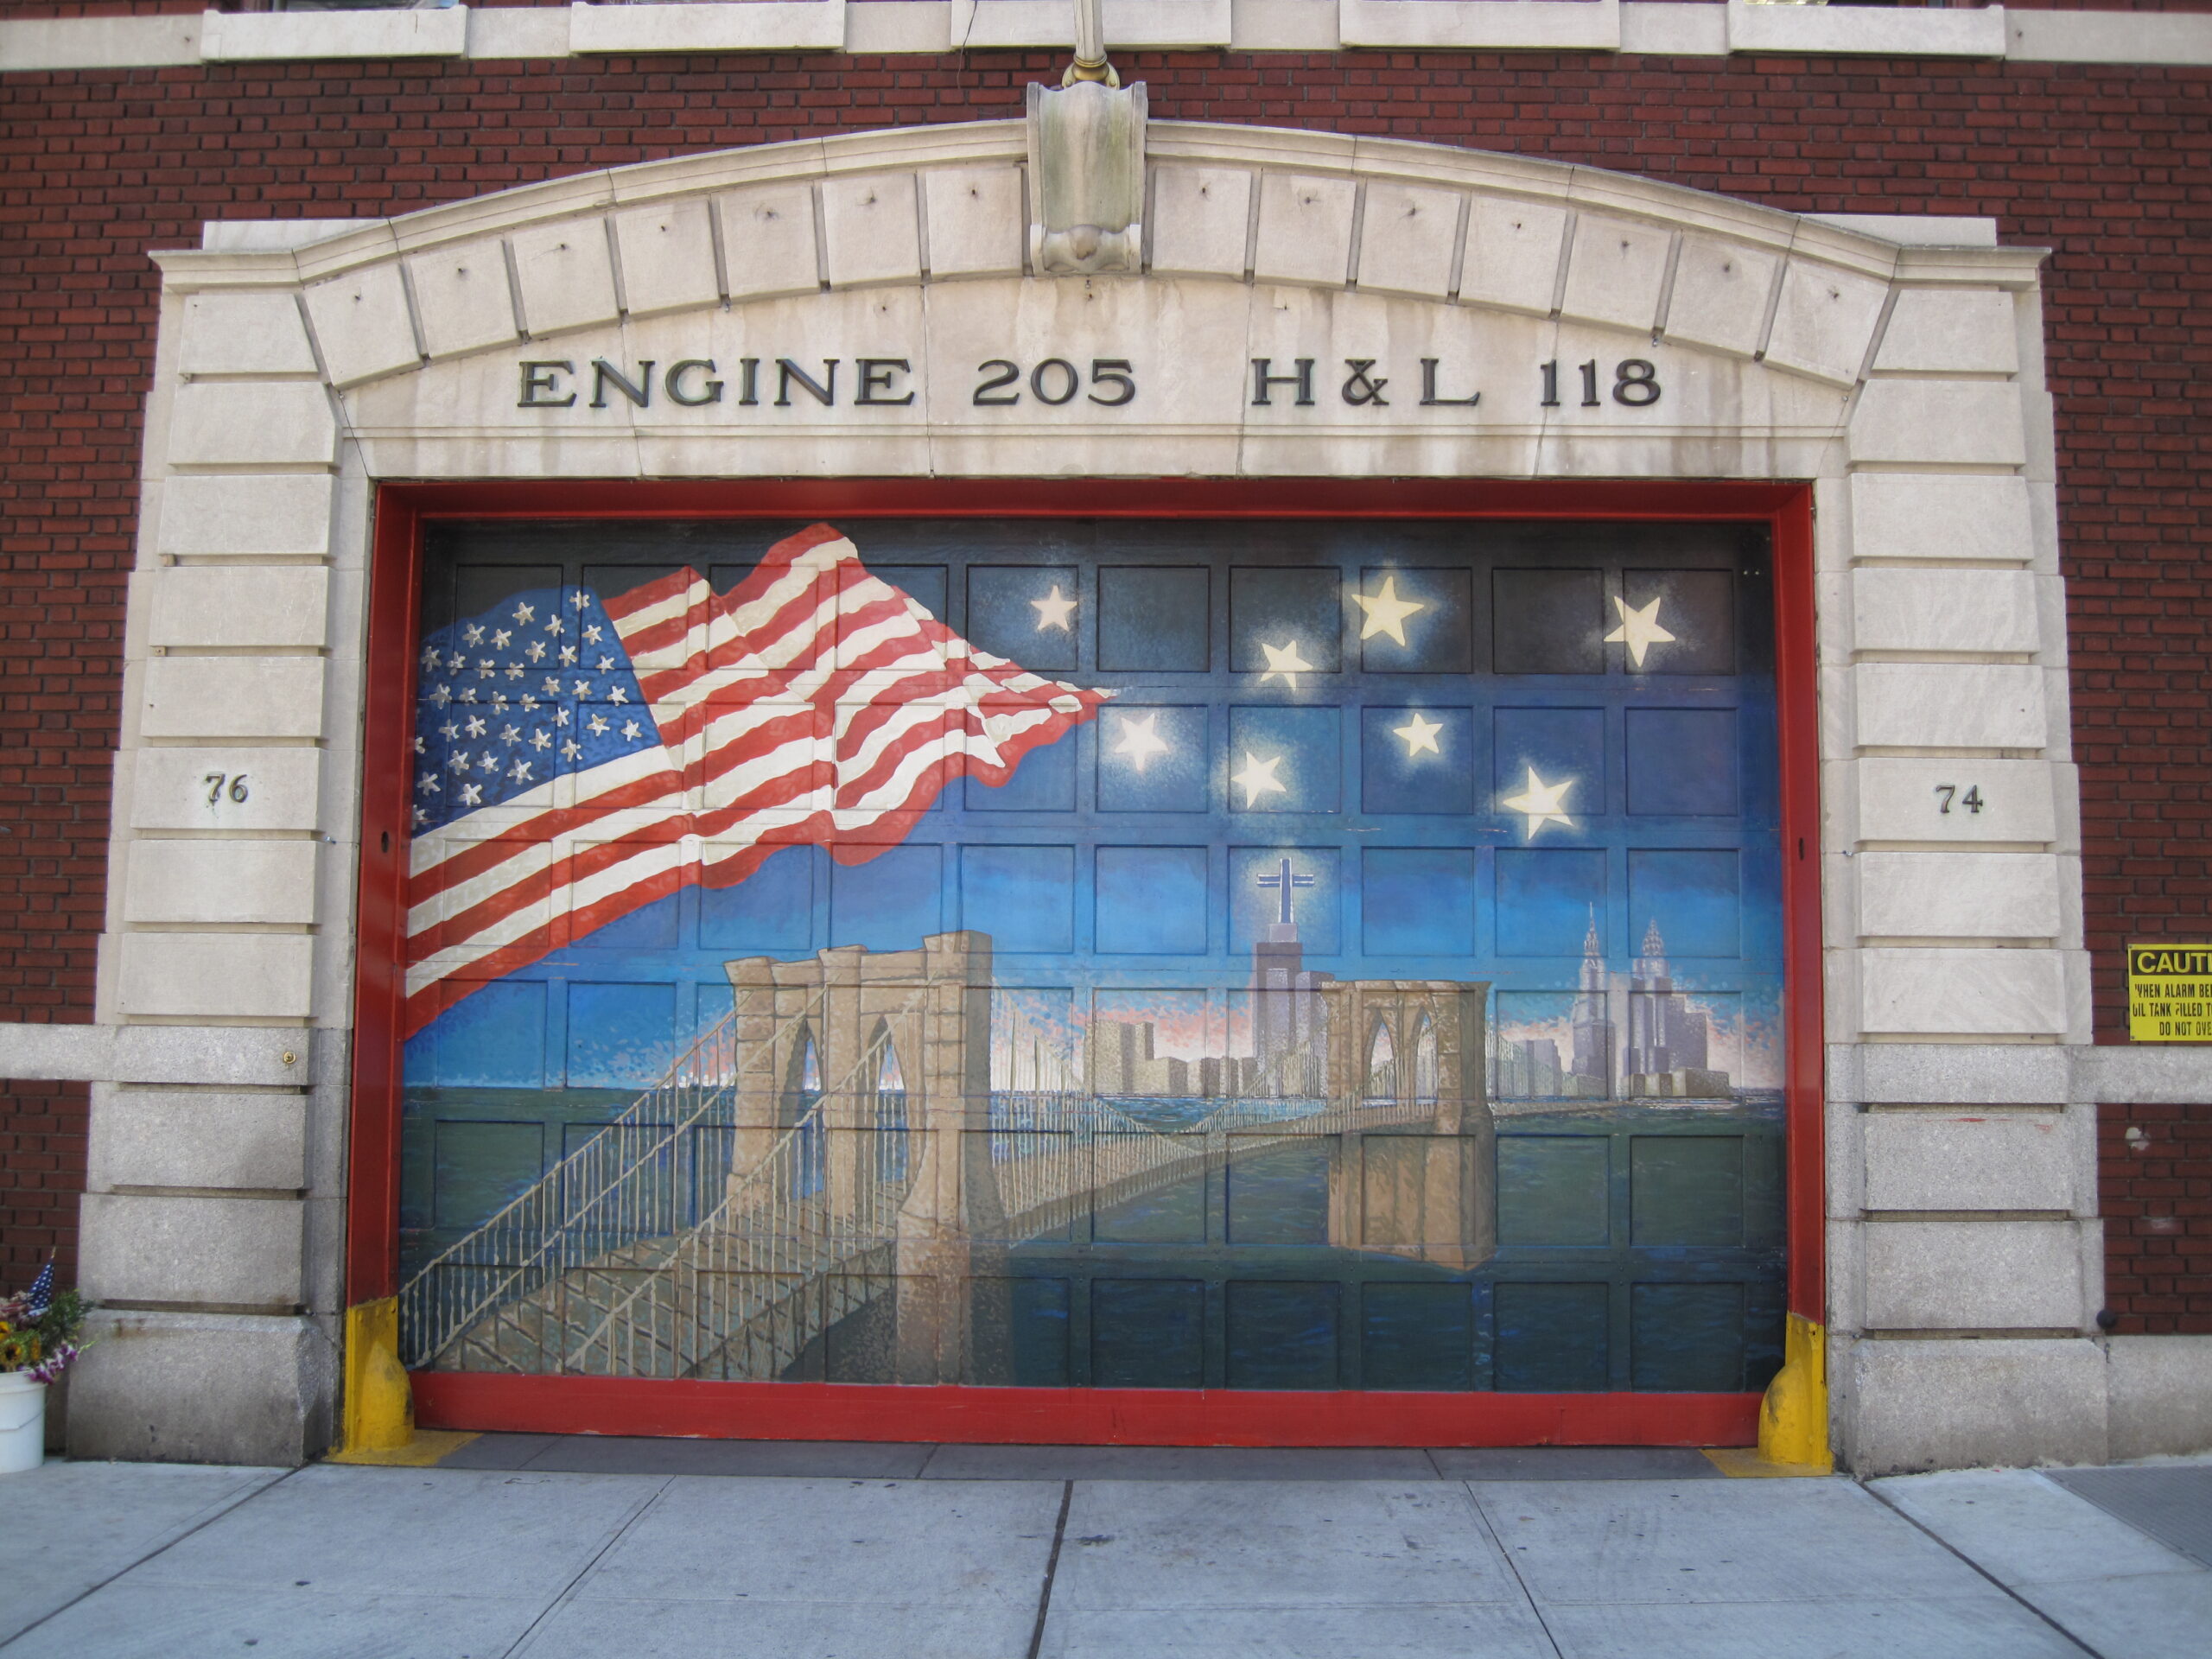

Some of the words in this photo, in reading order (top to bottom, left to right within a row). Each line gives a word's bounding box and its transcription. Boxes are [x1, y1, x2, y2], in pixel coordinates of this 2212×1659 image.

[517, 357, 916, 409] ENGINE
[972, 358, 1136, 407] 205
[1541, 358, 1662, 407] 118
[205, 773, 249, 804] 76
[1936, 784, 1984, 814] 74
[2164, 983, 2195, 999] ALARM
[2149, 1002, 2171, 1017] TANK
[2159, 1021, 2171, 1036] DO
[2175, 1021, 2192, 1036] NOT
